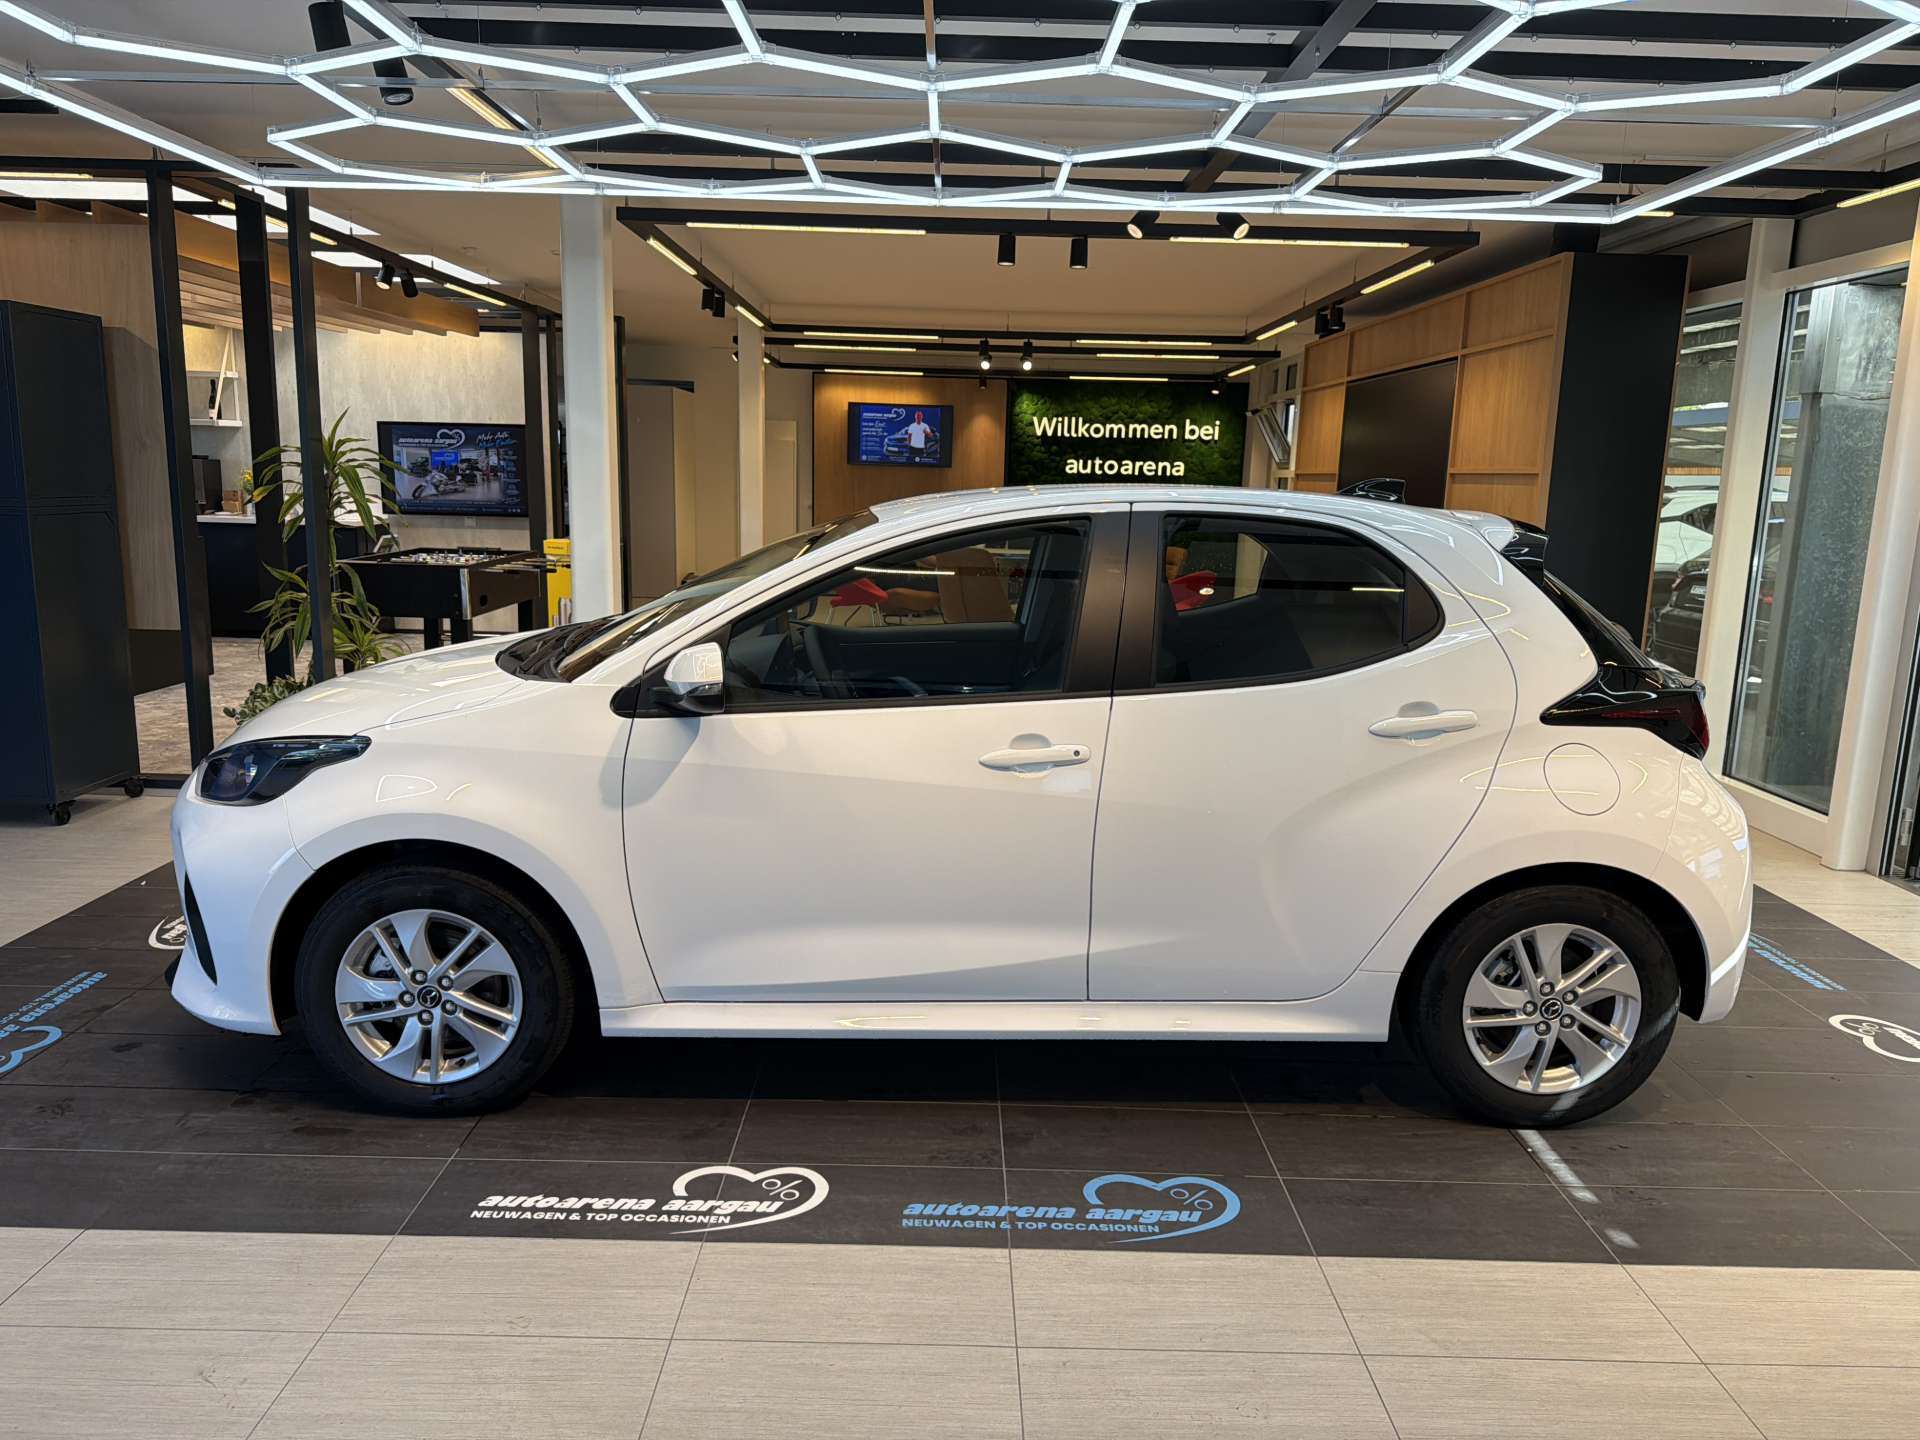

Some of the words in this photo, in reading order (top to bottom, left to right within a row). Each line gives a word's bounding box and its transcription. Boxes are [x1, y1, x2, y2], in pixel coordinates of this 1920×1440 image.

[1032, 416, 1177, 439] Willkommen
[1184, 418, 1221, 441] bei
[1065, 456, 1186, 477] autoarena
[478, 1194, 657, 1212] autoarena
[662, 1198, 785, 1215] aargau
[902, 1201, 1078, 1219] autoarena
[1085, 1206, 1204, 1224] aargau
[470, 1209, 567, 1221] NEUWAGEN
[569, 1211, 582, 1221] &
[586, 1212, 623, 1222] TOP
[623, 1213, 732, 1225] OCCASIONEN
[901, 1217, 997, 1230] NEUWAGEN
[999, 1219, 1012, 1230] &
[1014, 1220, 1048, 1231] TOP
[1053, 1221, 1161, 1233] OCCASIONEN
